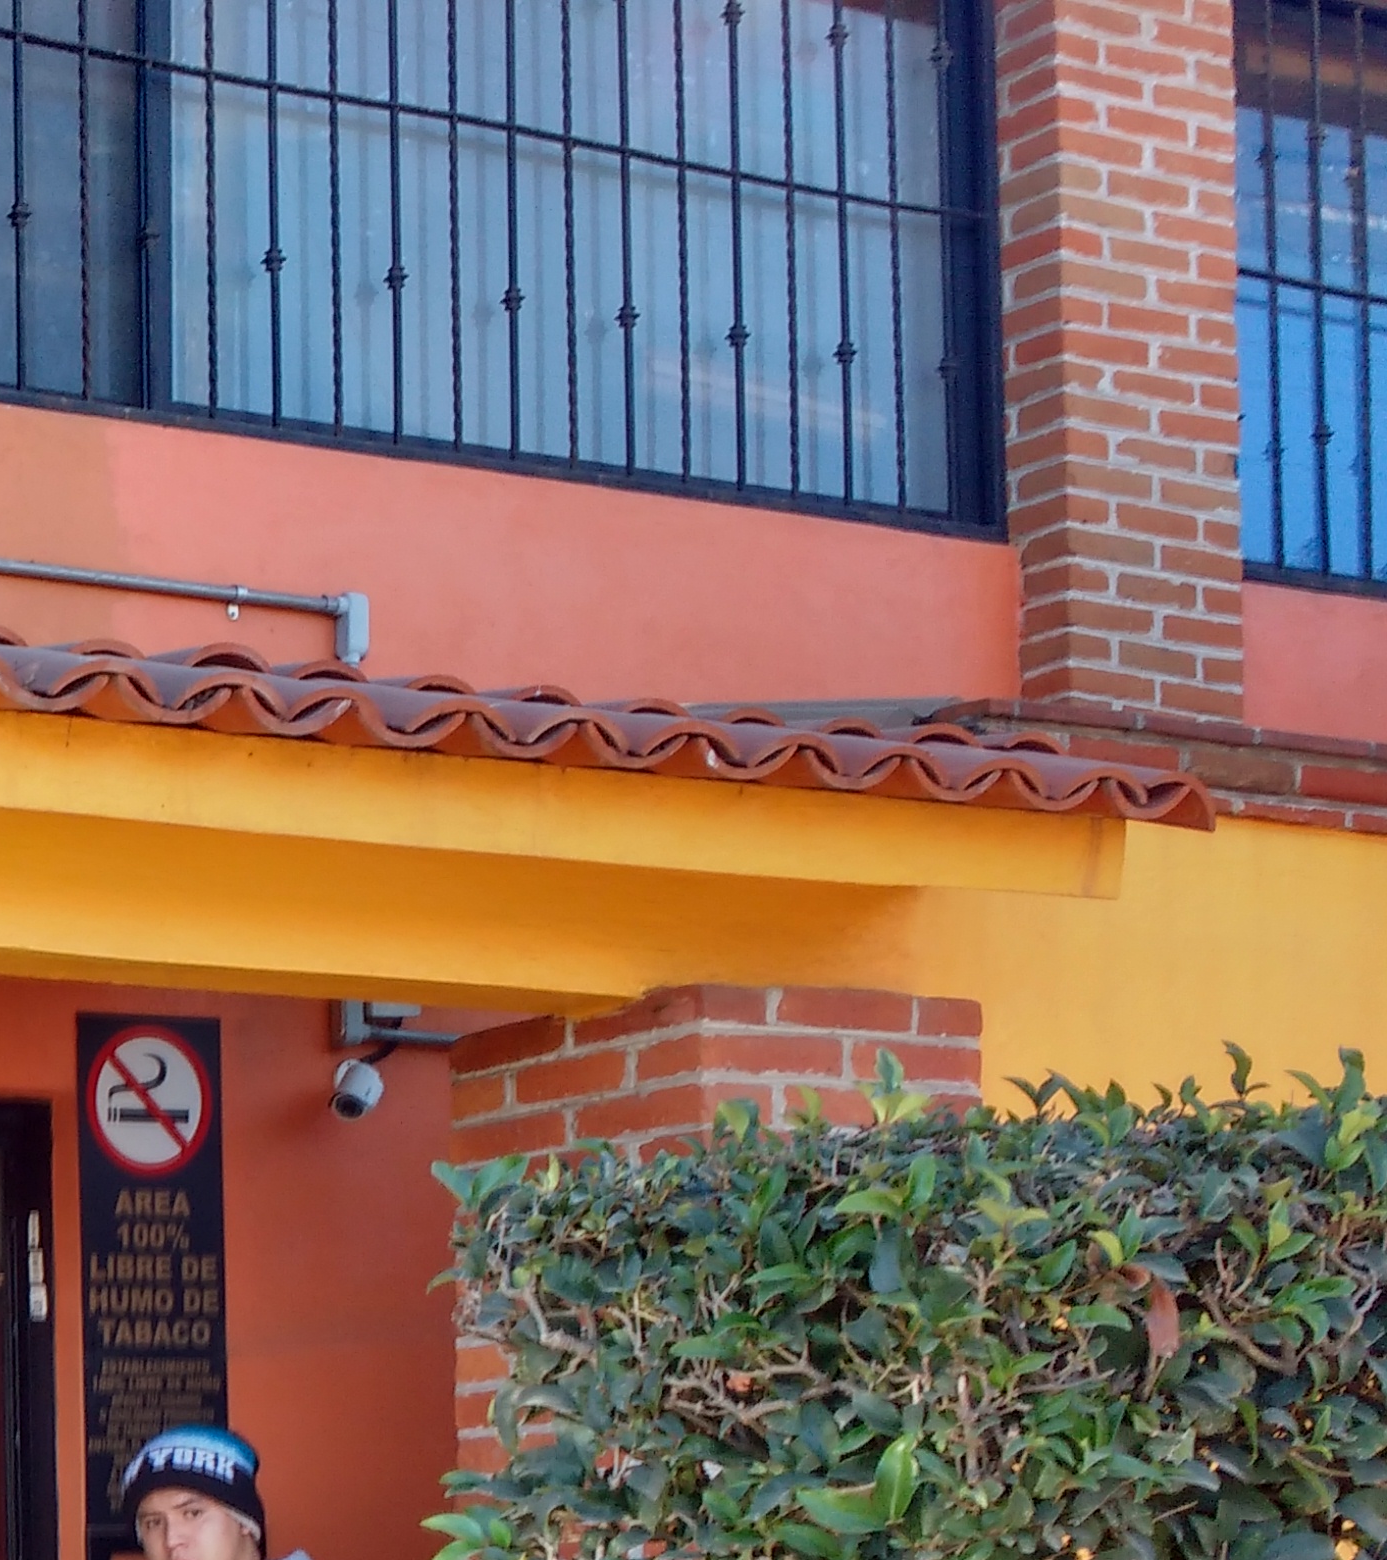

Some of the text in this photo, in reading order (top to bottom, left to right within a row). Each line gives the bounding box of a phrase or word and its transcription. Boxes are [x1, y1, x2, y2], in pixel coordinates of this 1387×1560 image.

[115, 1189, 191, 1217] AREA
[117, 1222, 190, 1250] 100%
[90, 1252, 217, 1282] LIBRE DE
[89, 1285, 220, 1315] HUMO DE
[98, 1318, 212, 1347] TABACO
[147, 1446, 235, 1486] YORK
